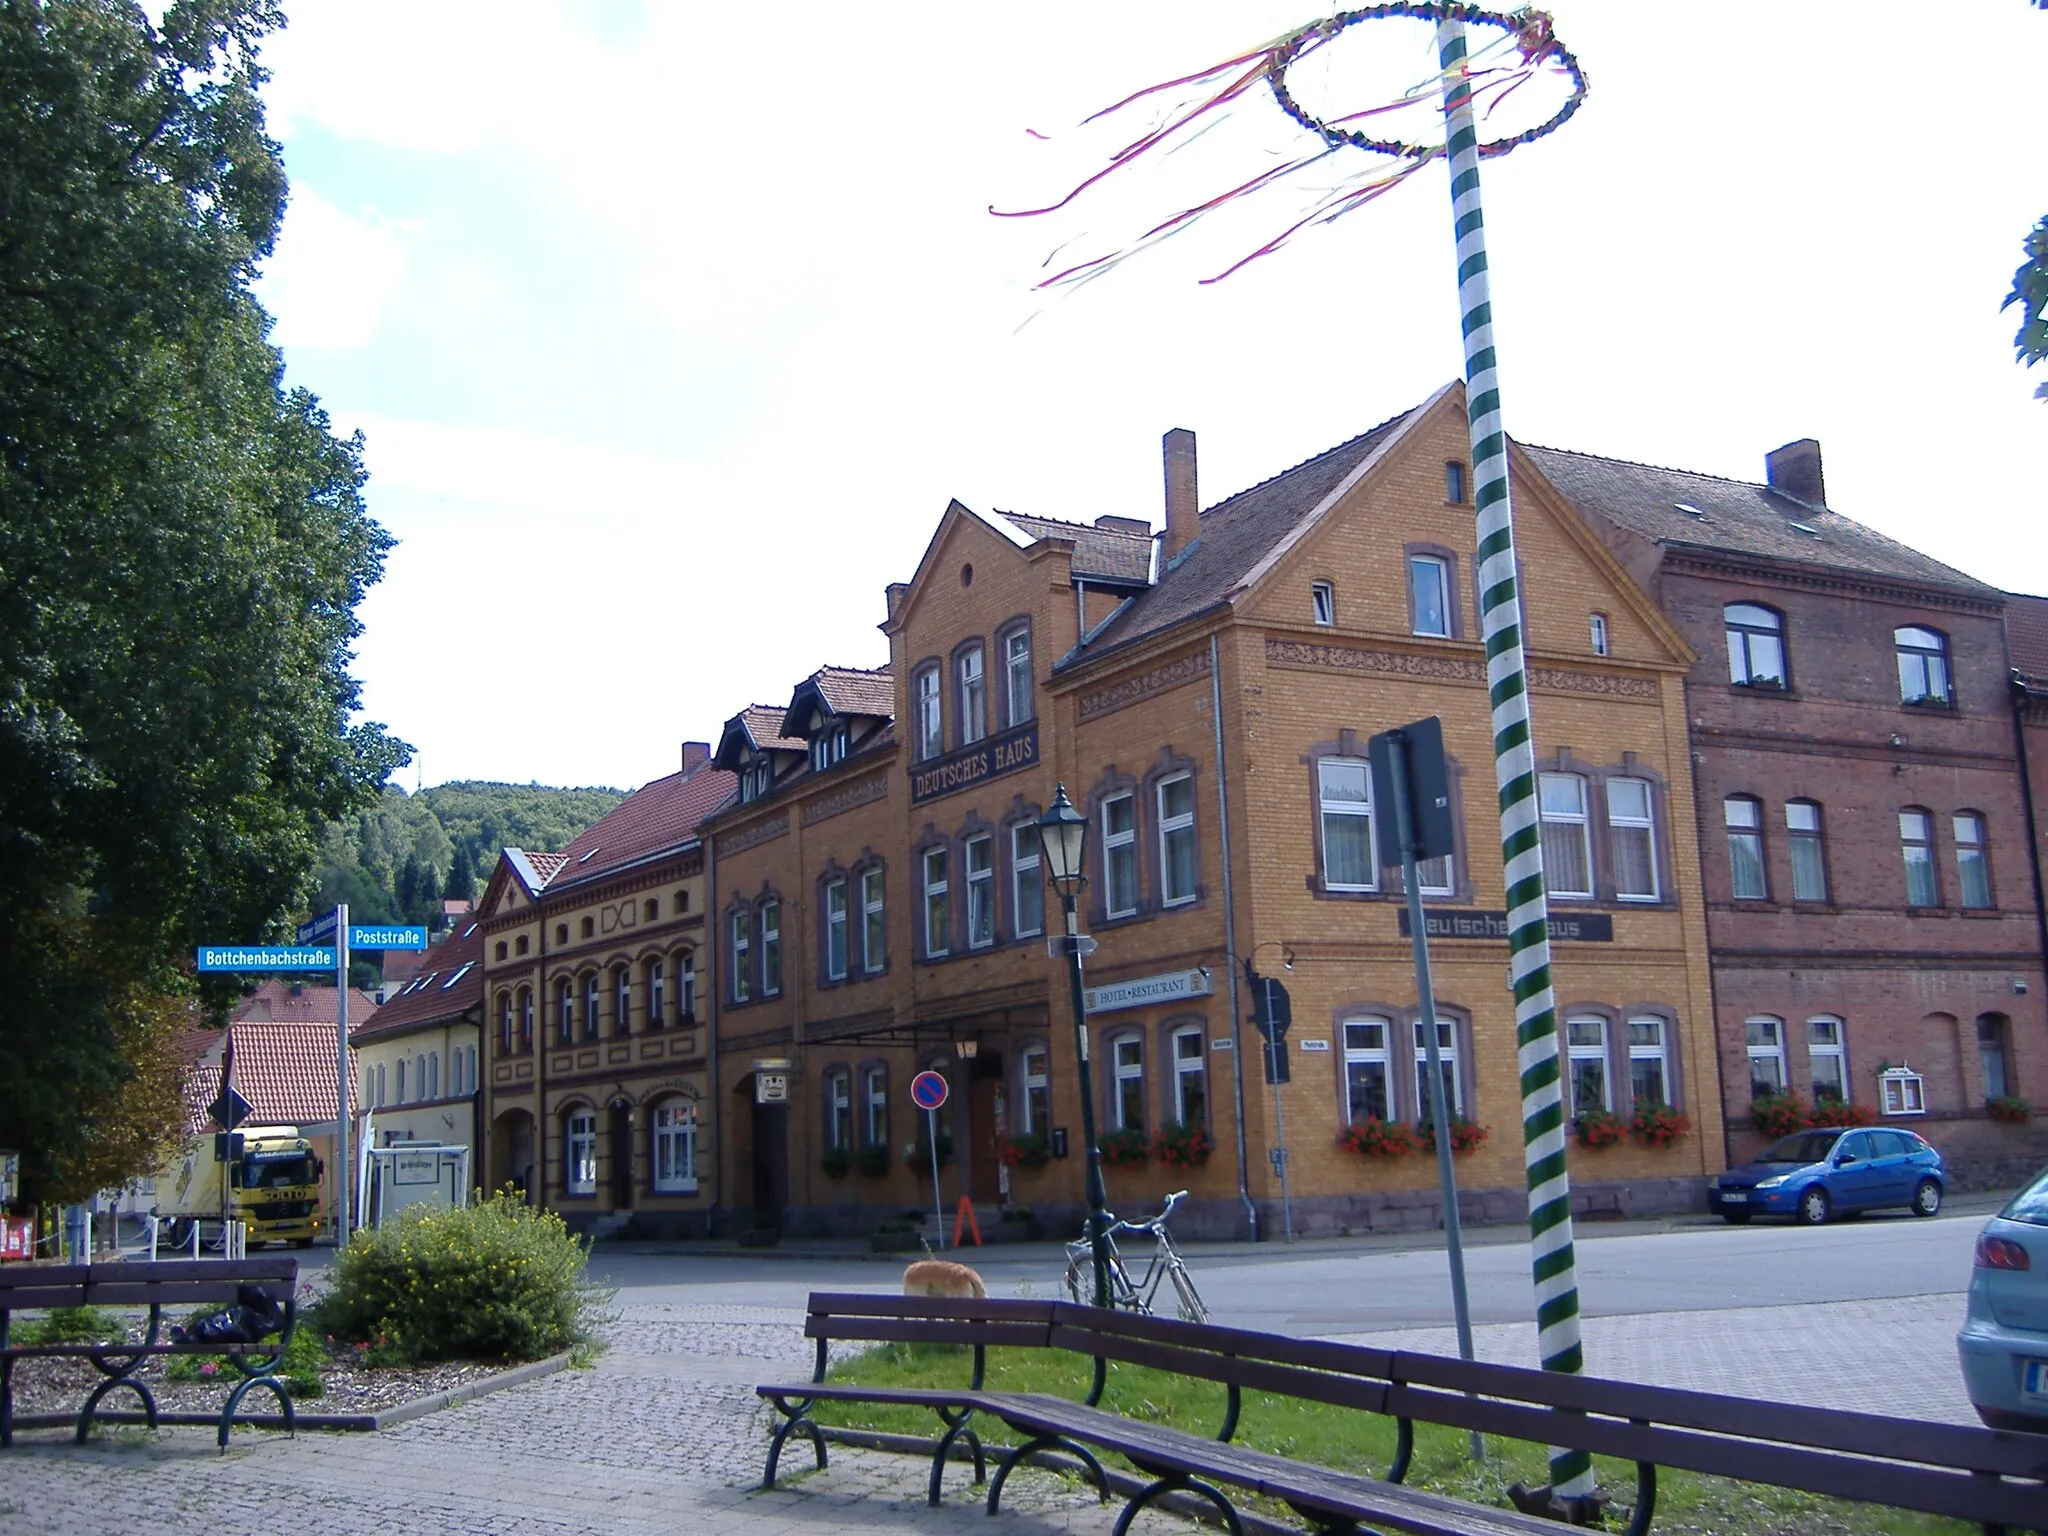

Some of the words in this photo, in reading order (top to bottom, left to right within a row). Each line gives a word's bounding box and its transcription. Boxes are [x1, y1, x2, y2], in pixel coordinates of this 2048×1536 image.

[917, 753, 988, 797] DEUTSCHES
[995, 736, 1033, 770] HAUS
[355, 929, 420, 944] Poststraße
[1426, 916, 1508, 936] eutsche
[1547, 920, 1581, 937] aus
[206, 950, 331, 965] Bottchenbachstraße
[1100, 989, 1128, 1004] HOTEL
[1131, 979, 1185, 999] RESTAURANT
